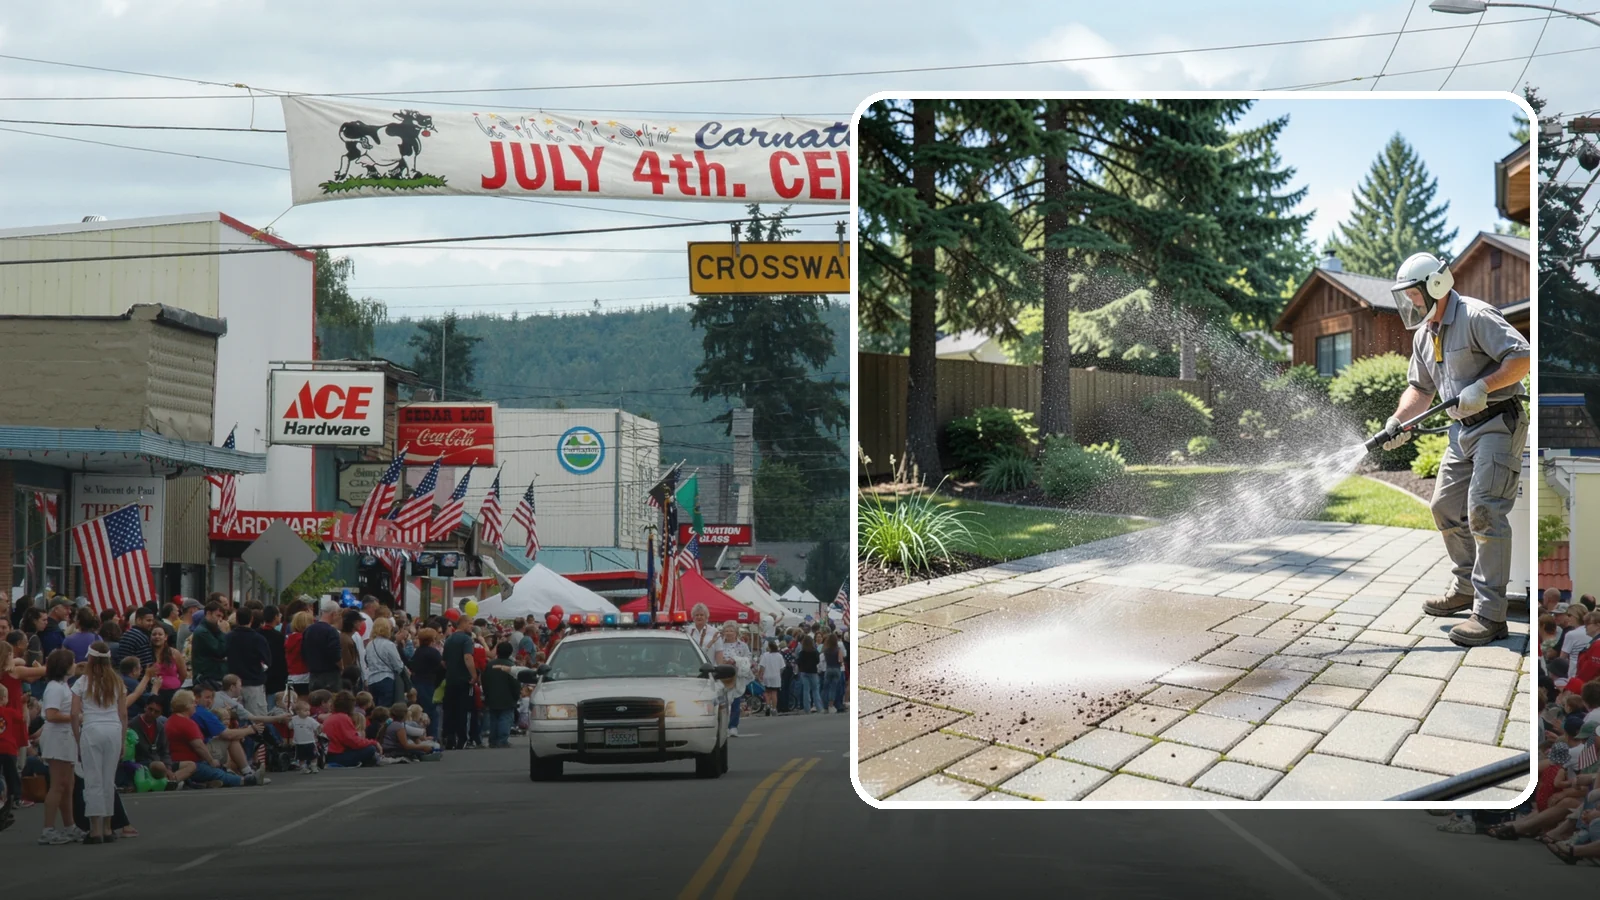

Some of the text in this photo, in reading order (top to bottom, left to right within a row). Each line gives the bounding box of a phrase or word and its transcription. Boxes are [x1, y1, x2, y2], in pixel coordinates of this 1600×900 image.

[481, 141, 604, 192] JULY
[633, 150, 746, 197] 4th.
[697, 254, 850, 280] CROSSWA
[283, 380, 373, 419] ACE
[406, 409, 452, 422] CEDAR
[284, 421, 370, 436] Hardware
[416, 428, 477, 446] Coca-Cola
[83, 485, 155, 495] St. Vincent de Paul
[688, 526, 741, 534] CRNATION
[699, 535, 730, 543] GLASS
